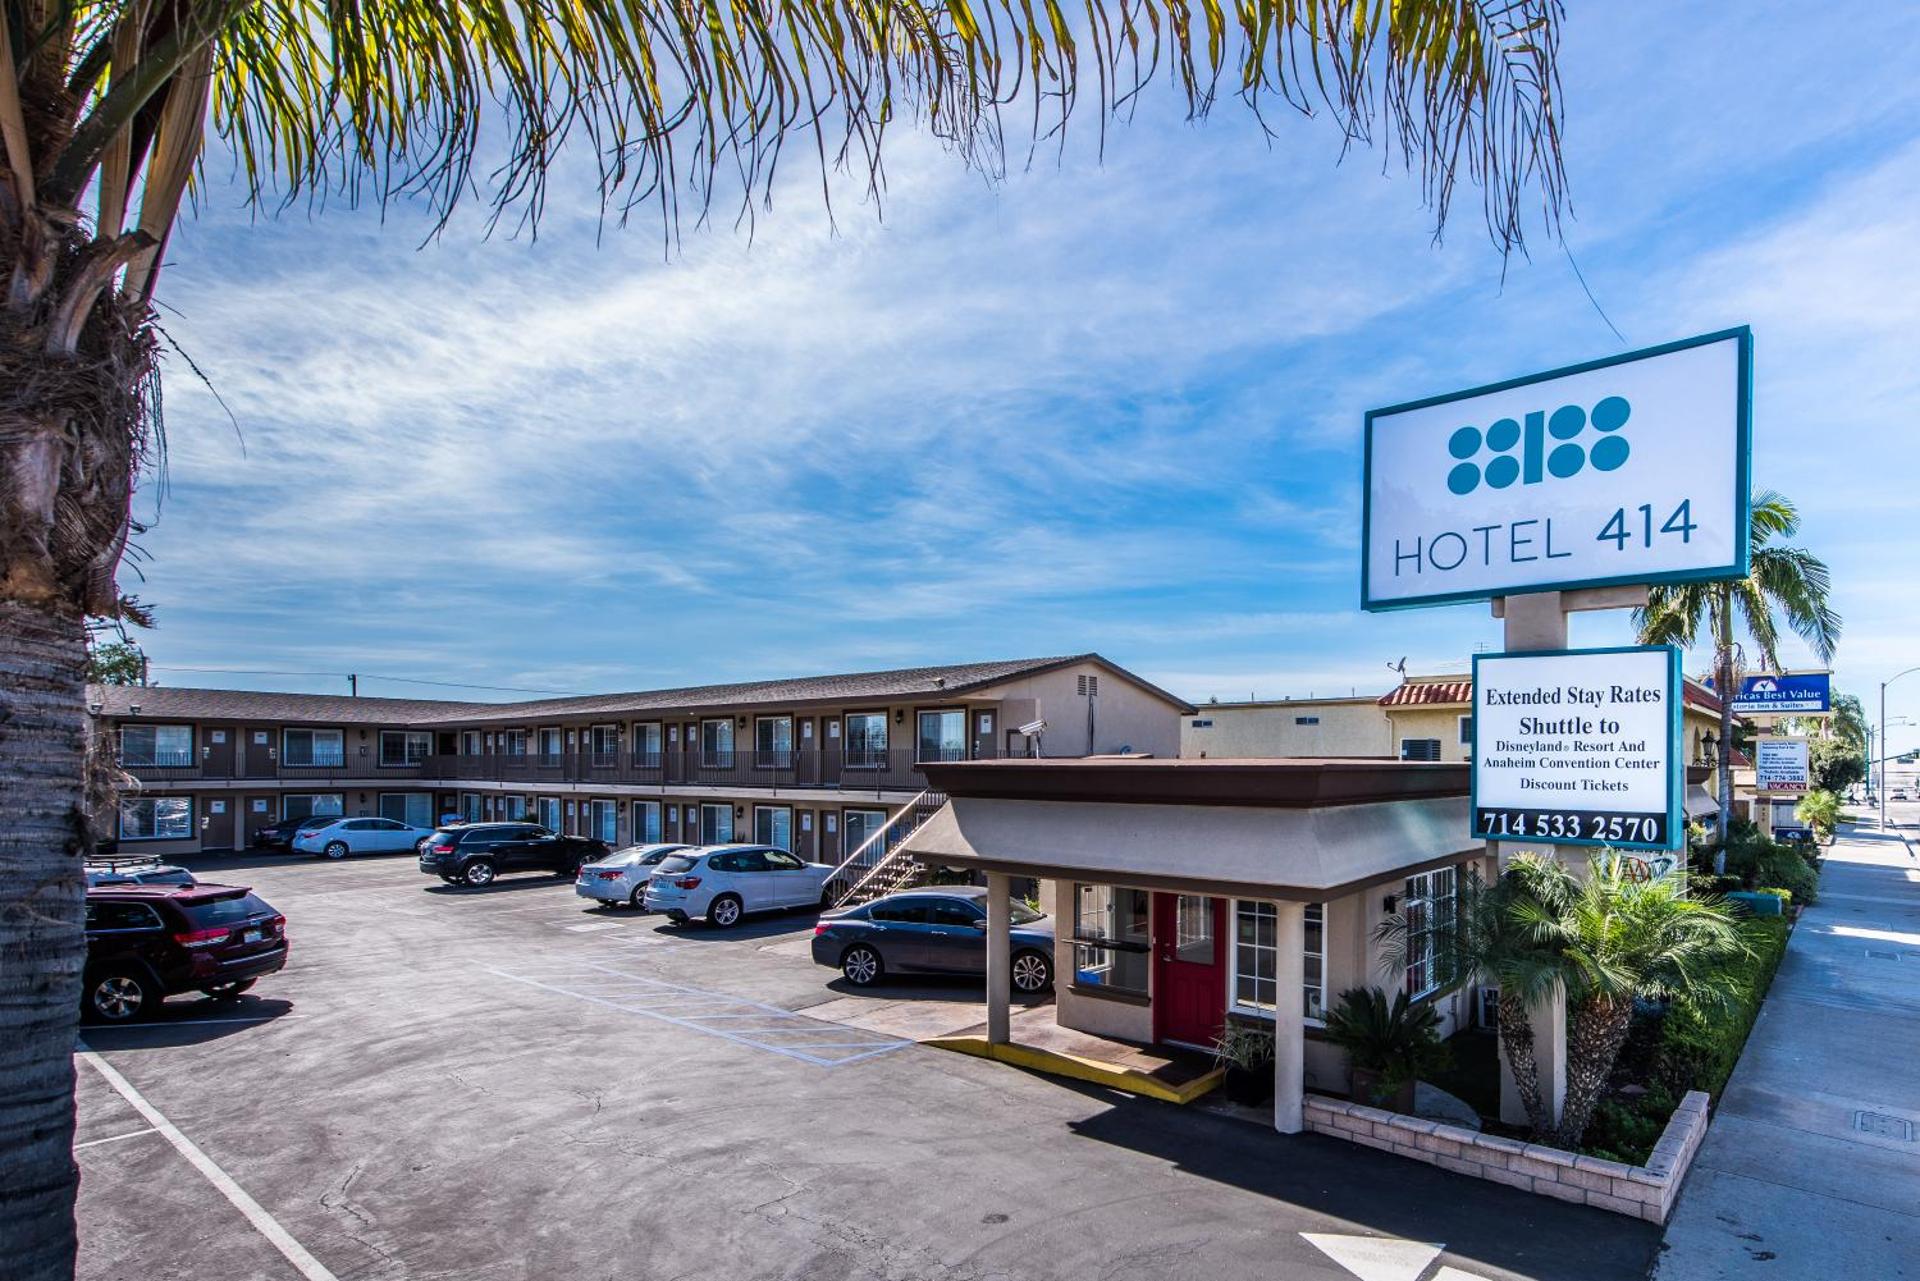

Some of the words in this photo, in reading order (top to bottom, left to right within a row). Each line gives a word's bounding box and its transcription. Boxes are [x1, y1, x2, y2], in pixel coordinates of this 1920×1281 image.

[1395, 518, 1572, 577] HOTEL
[1596, 498, 1698, 551] 414
[1486, 687, 1561, 706] Extended
[1567, 686, 1605, 709] Stay
[1610, 685, 1662, 704] Rates
[1763, 690, 1786, 700] Best
[1789, 689, 1821, 699] Value
[1519, 717, 1593, 735] Shuttle
[1600, 718, 1620, 735] to
[1573, 740, 1614, 752] Resort
[1618, 740, 1646, 752] And
[1484, 757, 1536, 769] Anaheim
[1539, 757, 1610, 769] Convention
[1614, 758, 1660, 769] Center
[1520, 778, 1576, 791] Discount
[1581, 779, 1629, 792] Tickets
[1483, 813, 1526, 836] 714
[1536, 814, 1580, 838] 533
[1591, 816, 1658, 841] 2570
